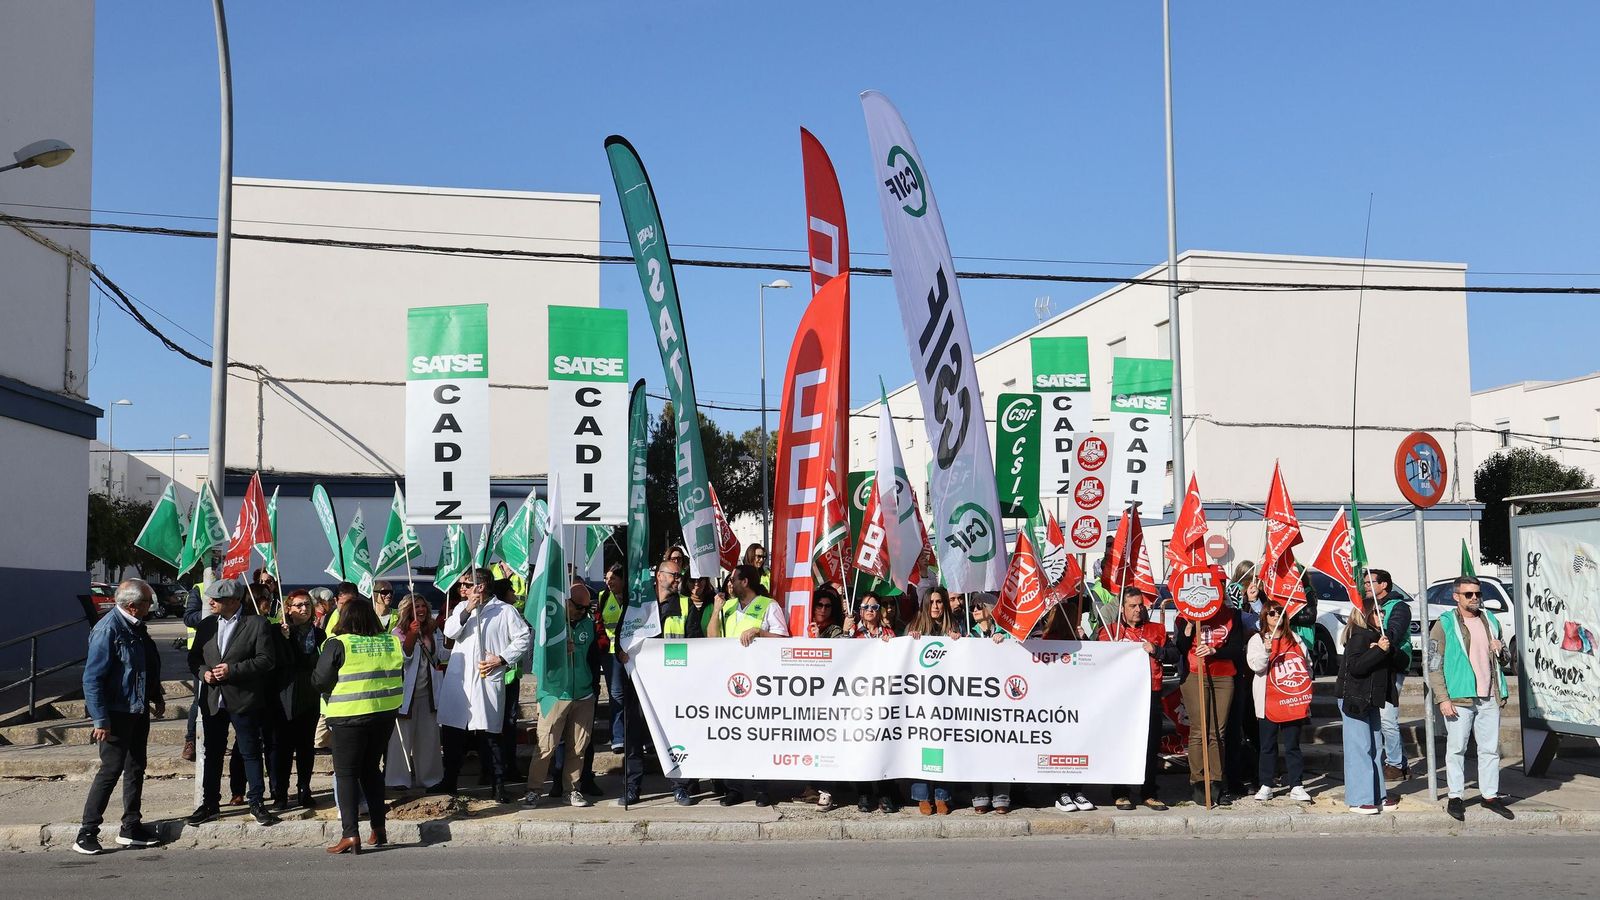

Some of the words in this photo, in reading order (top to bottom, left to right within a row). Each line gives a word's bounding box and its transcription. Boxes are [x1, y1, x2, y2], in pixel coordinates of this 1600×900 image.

[411, 353, 483, 374] SATSE
[553, 355, 623, 377] SATSE
[1036, 373, 1088, 388] SATSE
[1114, 393, 1168, 410] SATSE
[1008, 407, 1037, 422] CSIF
[432, 384, 463, 521] CADIZ
[573, 387, 603, 521] CADIZ
[1053, 396, 1074, 495] CADIZ
[1084, 440, 1102, 451] UGT
[1010, 437, 1026, 514] CSIF
[1124, 417, 1150, 517] CADIZ
[1081, 479, 1099, 490] UGT
[1077, 518, 1096, 529] UGT
[1184, 573, 1212, 588] UGT
[924, 649, 947, 660] CSIF
[1032, 653, 1058, 663] UGT
[1275, 657, 1308, 679] UGT
[756, 675, 824, 697] STOP
[832, 674, 1001, 698] AGRESIONES
[675, 705, 709, 719] LOS
[714, 705, 873, 721] INCUMPLIMIENTOS
[878, 706, 900, 720] DE
[905, 705, 926, 720] LA
[930, 705, 1079, 723] ADMINISTRACIÓN
[708, 726, 742, 741] LOS
[747, 727, 837, 742] SUFRIMOS
[842, 727, 902, 742] LOS/AS
[908, 726, 1052, 745] PROFESIONALES
[773, 754, 800, 766] UGT
[1051, 756, 1080, 764] CCOO
